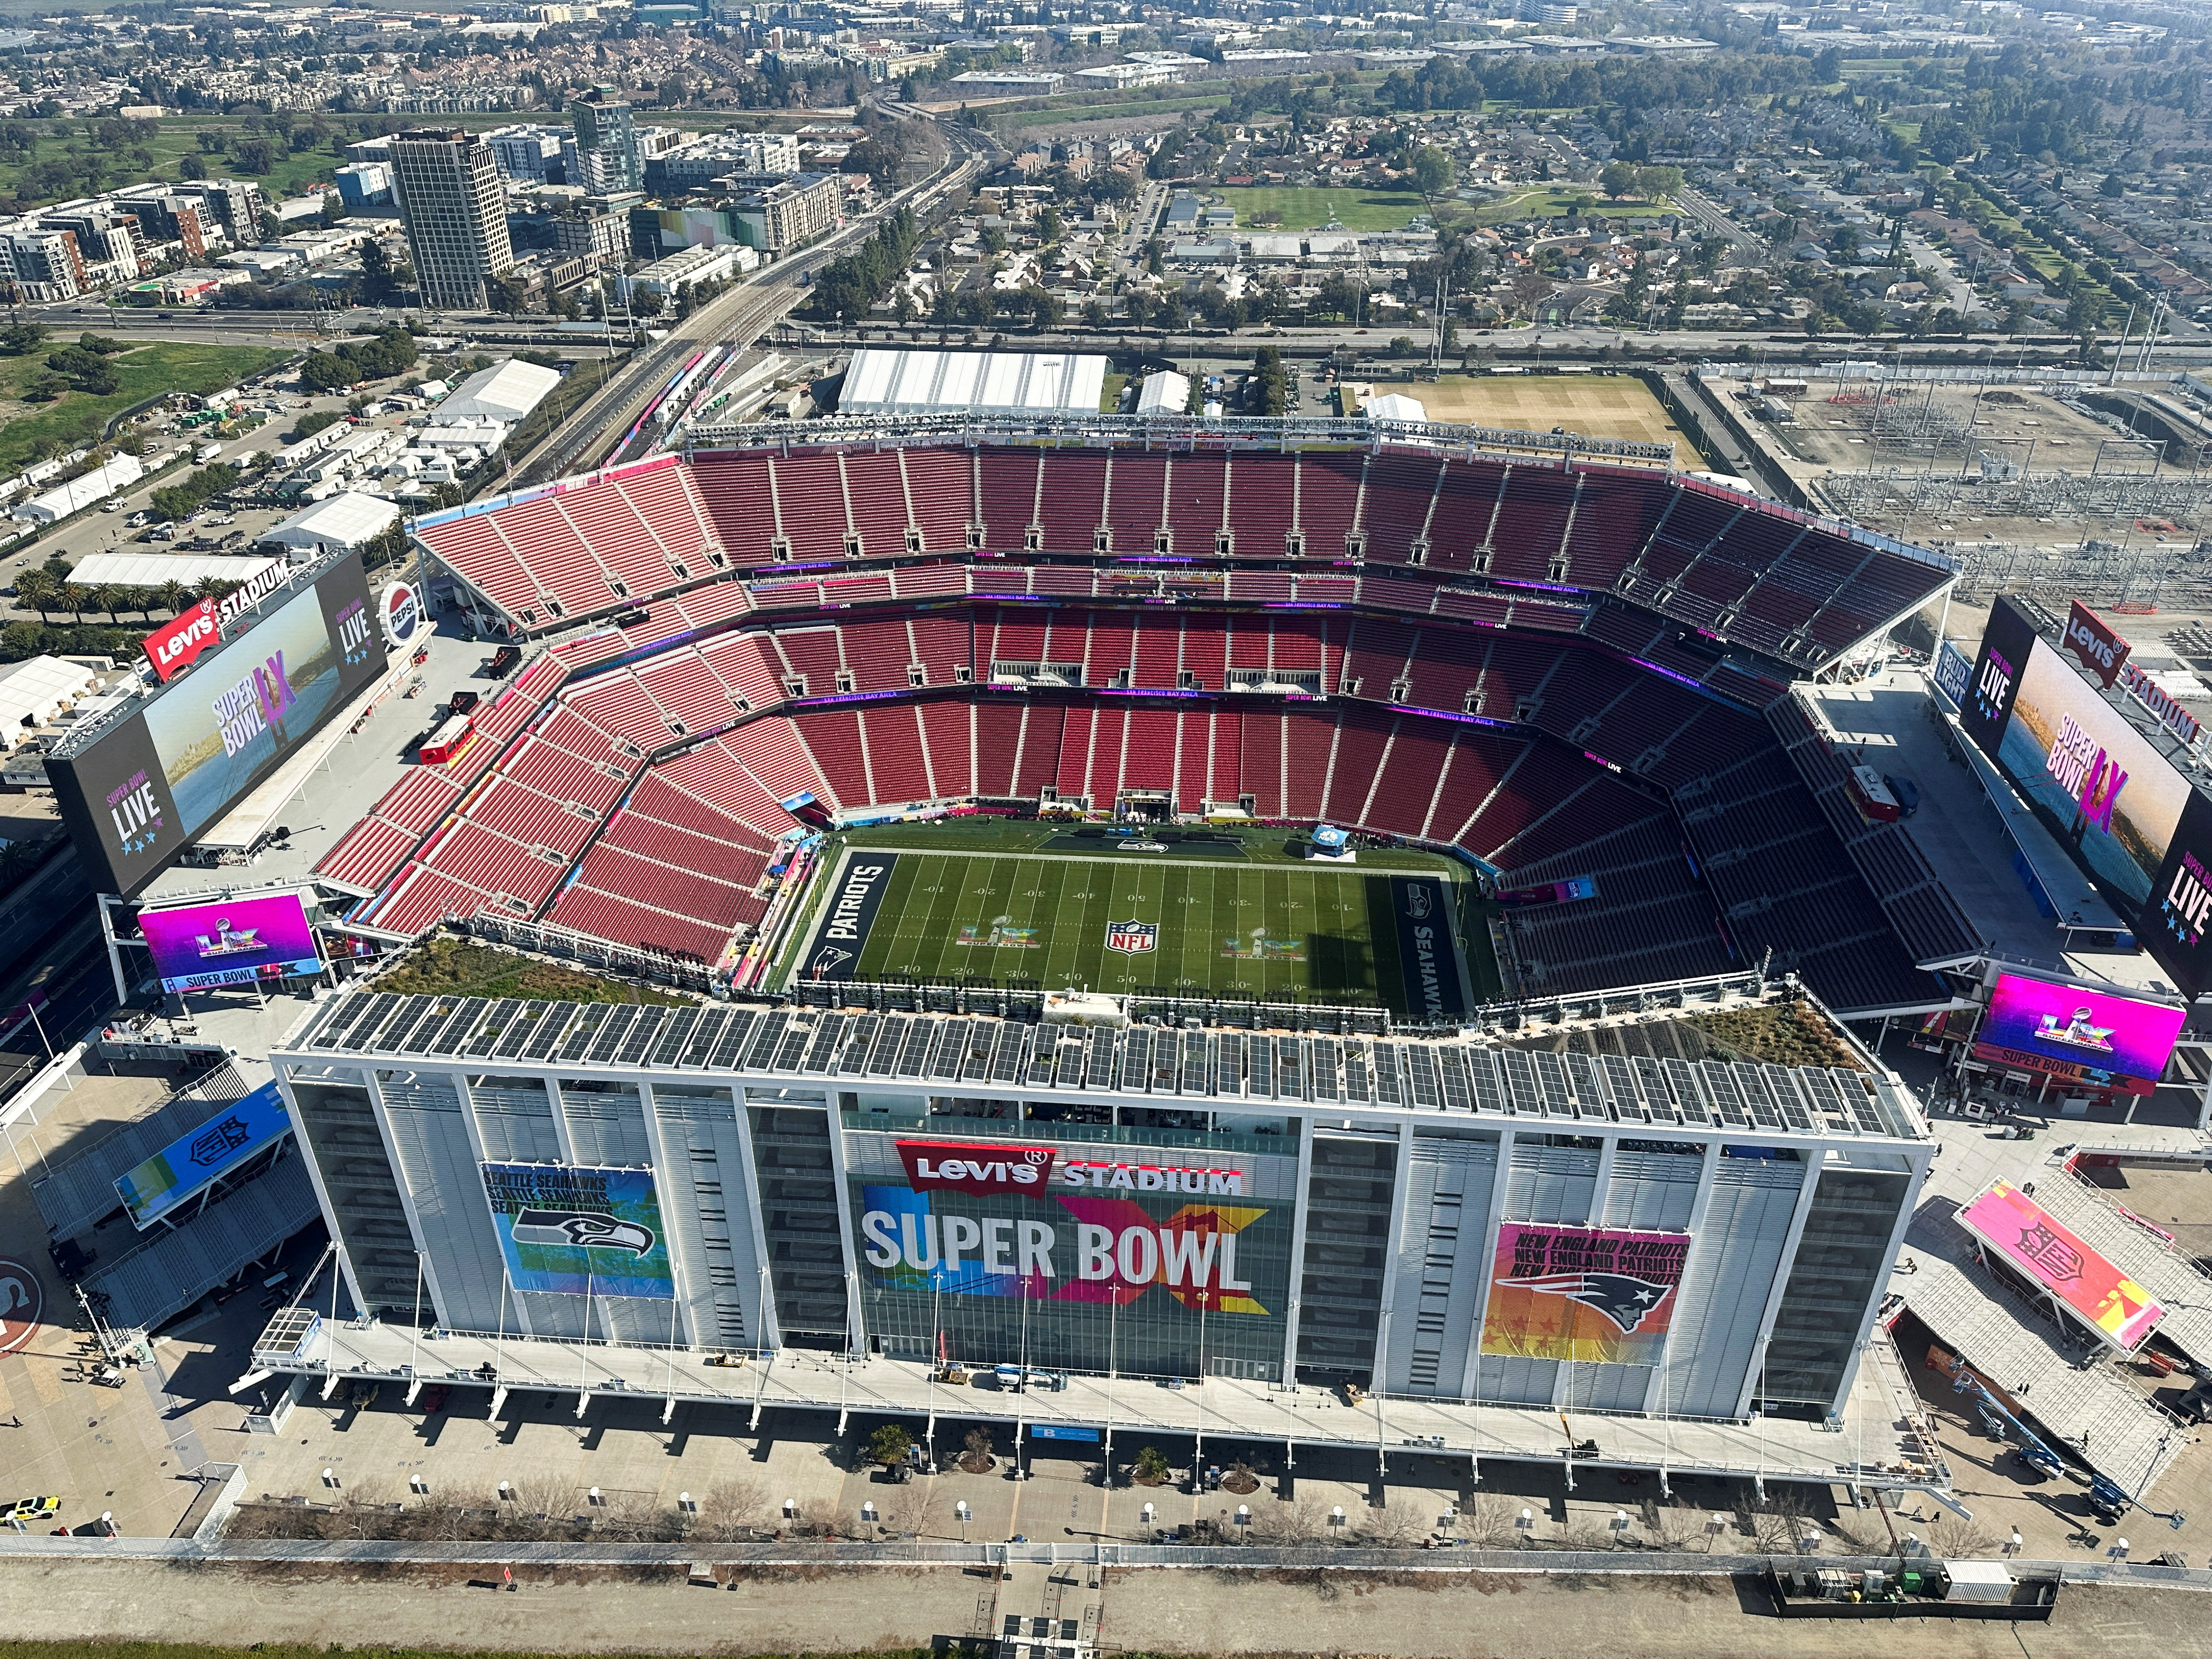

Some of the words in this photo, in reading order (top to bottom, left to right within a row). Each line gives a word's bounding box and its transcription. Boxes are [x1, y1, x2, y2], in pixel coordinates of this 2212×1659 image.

[879, 439, 963, 448] SEAHAWKS
[1431, 449, 1442, 458] NEW
[1443, 450, 1468, 460] ENGLAND
[1475, 455, 1555, 468] PATRIOTS
[219, 558, 289, 623] STADIUM
[336, 606, 351, 623] SUPER
[338, 607, 372, 654] LIVE
[391, 601, 416, 628] PEPSI
[1936, 662, 1966, 704] LIGHT
[1945, 650, 1966, 683] BUD
[252, 650, 298, 725] LX
[1979, 658, 2011, 710] LIVE
[212, 675, 260, 728] SUPER
[1430, 710, 1459, 720] FRANCISCO
[1475, 718, 1494, 726] AREA
[2120, 663, 2197, 741] STADIUM
[220, 703, 268, 758] BOWL
[2057, 712, 2097, 770] SUPER
[1607, 762, 1622, 774] LIVE
[2046, 738, 2085, 802] BOWL
[106, 785, 129, 808] SUPER
[128, 769, 149, 793] BOWL
[2080, 747, 2129, 837] LX
[111, 780, 160, 842] LIVE
[2183, 851, 2204, 879] SUPER
[826, 865, 884, 940] PATRIOTS
[2168, 865, 2212, 936] LIVE
[1111, 934, 1150, 951] NFL
[186, 974, 220, 988] SUPER
[223, 969, 255, 984] BOWL
[2002, 1049, 2041, 1069] SUPER
[2042, 1057, 2078, 1077] BOWL
[196, 1130, 228, 1163] NFL
[484, 1171, 533, 1187] SEATTLE
[537, 1174, 607, 1191] SEAHAWKS
[487, 1186, 539, 1201] SEATTLE
[538, 1188, 611, 1205] SEAHAWKS
[1064, 1166, 1242, 1196] STADIUM
[862, 1210, 1056, 1278] SUPER
[1078, 1223, 1251, 1291] BOWL
[1515, 1233, 1550, 1249] NEW
[1551, 1236, 1620, 1253] ENGLAND
[1620, 1240, 1690, 1257] PATRIOTS
[1515, 1249, 1546, 1263] NEW
[1550, 1250, 1614, 1268] ENGLAND
[1618, 1256, 1685, 1273] PATRIOTS
[2037, 1243, 2079, 1277] NFL
[1510, 1263, 1546, 1277] NEW
[1044, 1429, 1056, 1437] B
